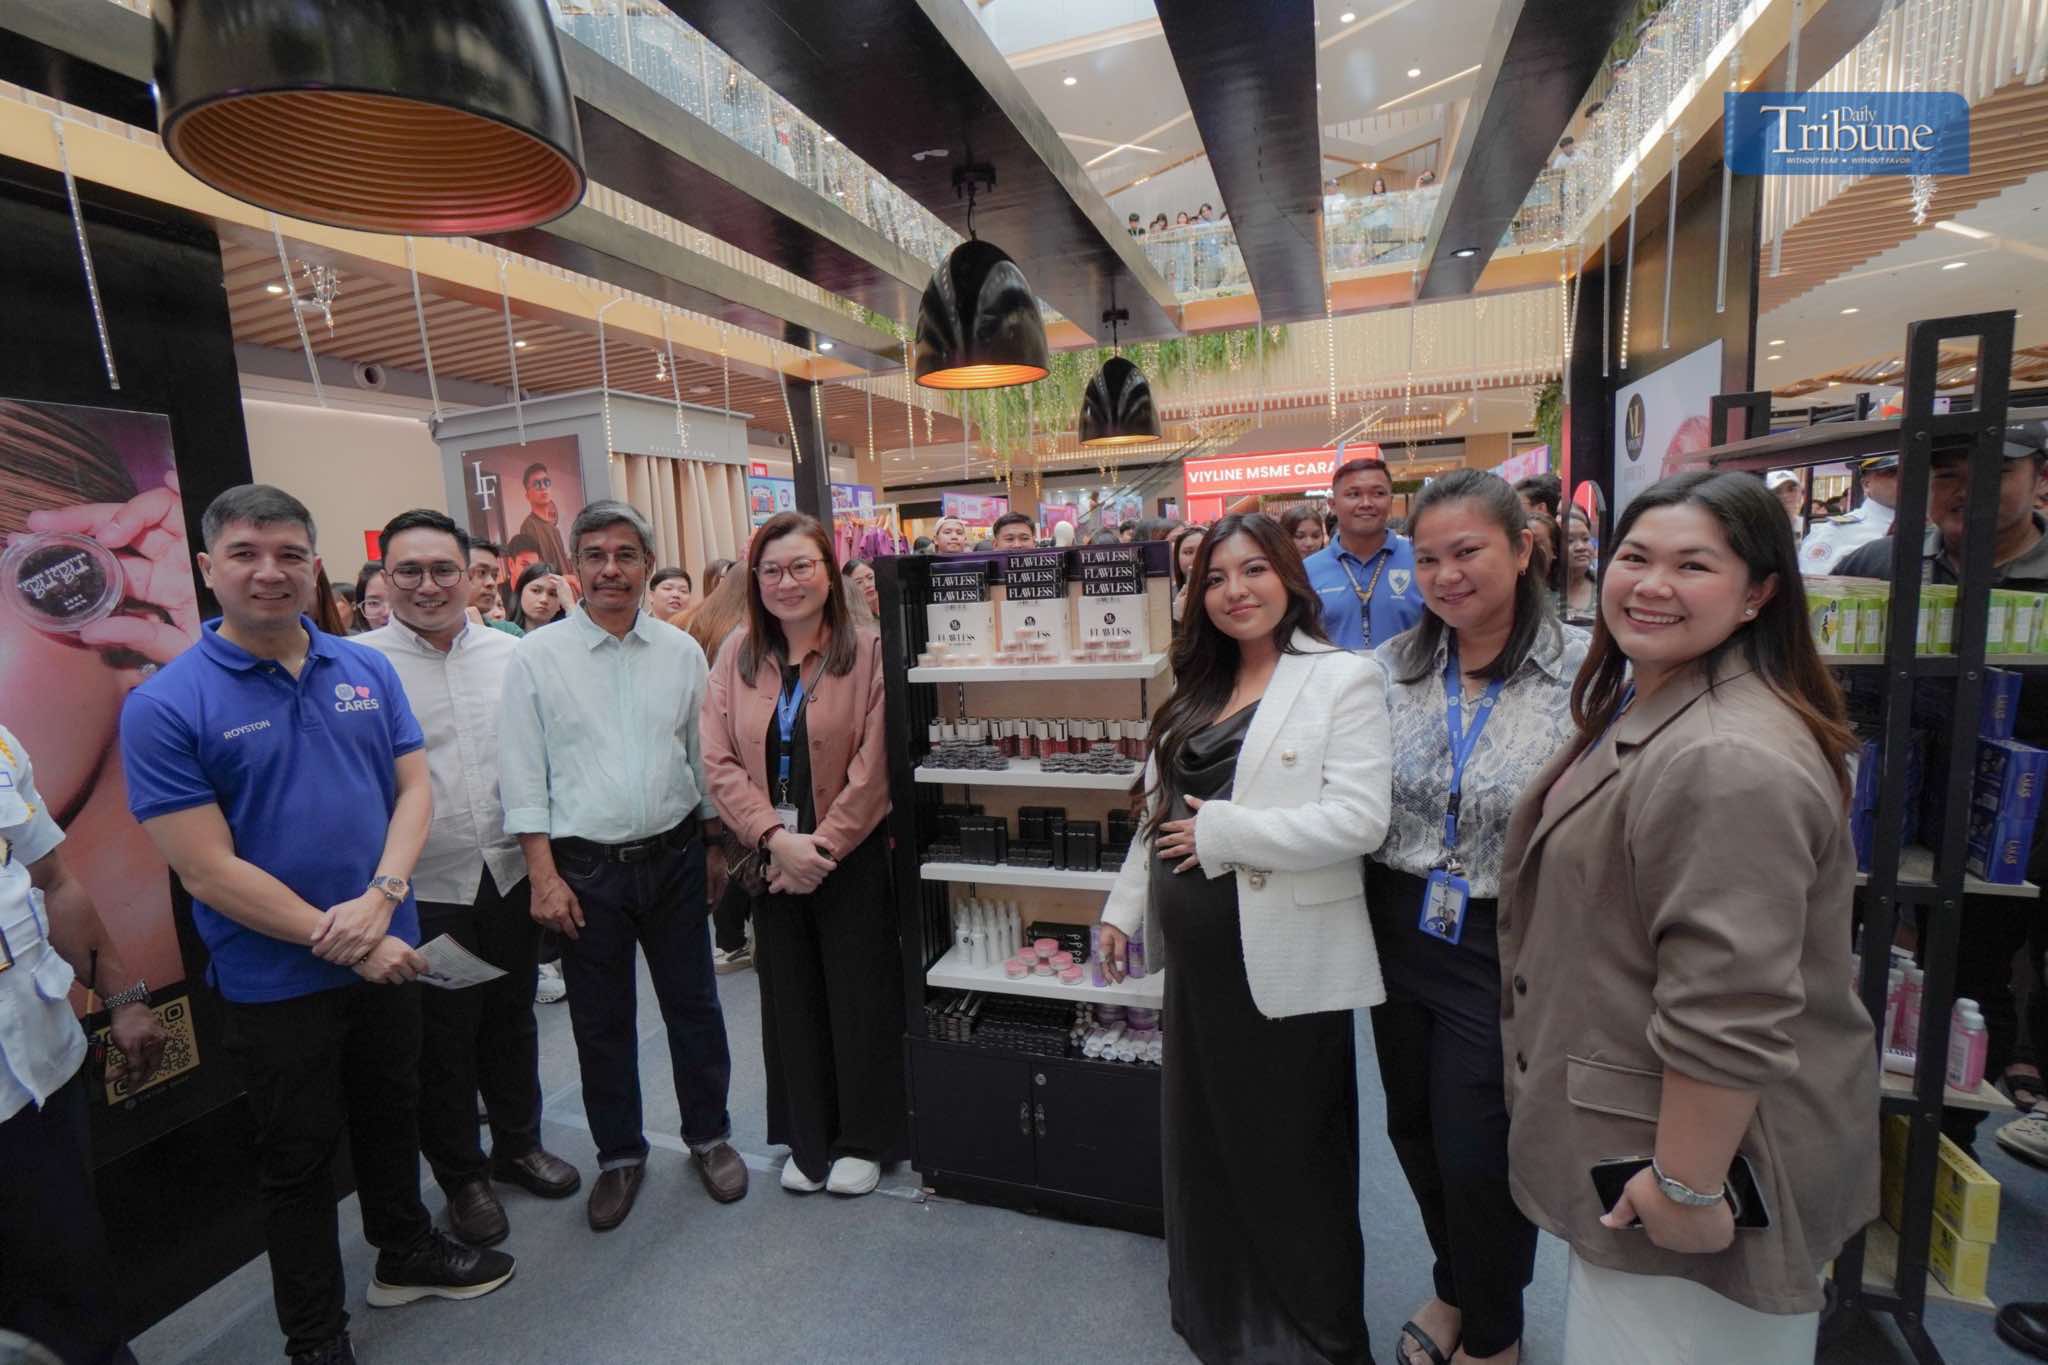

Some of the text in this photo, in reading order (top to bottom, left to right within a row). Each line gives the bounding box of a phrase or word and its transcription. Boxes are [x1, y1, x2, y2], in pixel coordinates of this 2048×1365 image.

[1188, 467, 1244, 484] VIYLINE
[1246, 464, 1291, 480] MSME
[1010, 556, 1056, 568] FLAWLESS
[1081, 551, 1129, 564] FLAWLESS
[1008, 571, 1053, 583] FLAWLESS
[1084, 567, 1133, 579] FLAWLESS
[932, 575, 976, 587] FLAWLESS
[1009, 587, 1053, 598] FLAWLESS
[1085, 582, 1134, 594] FLAWLESS
[933, 590, 977, 601] FLAWLESS
[335, 698, 380, 713] CARES
[223, 719, 271, 740] ROYSTON
